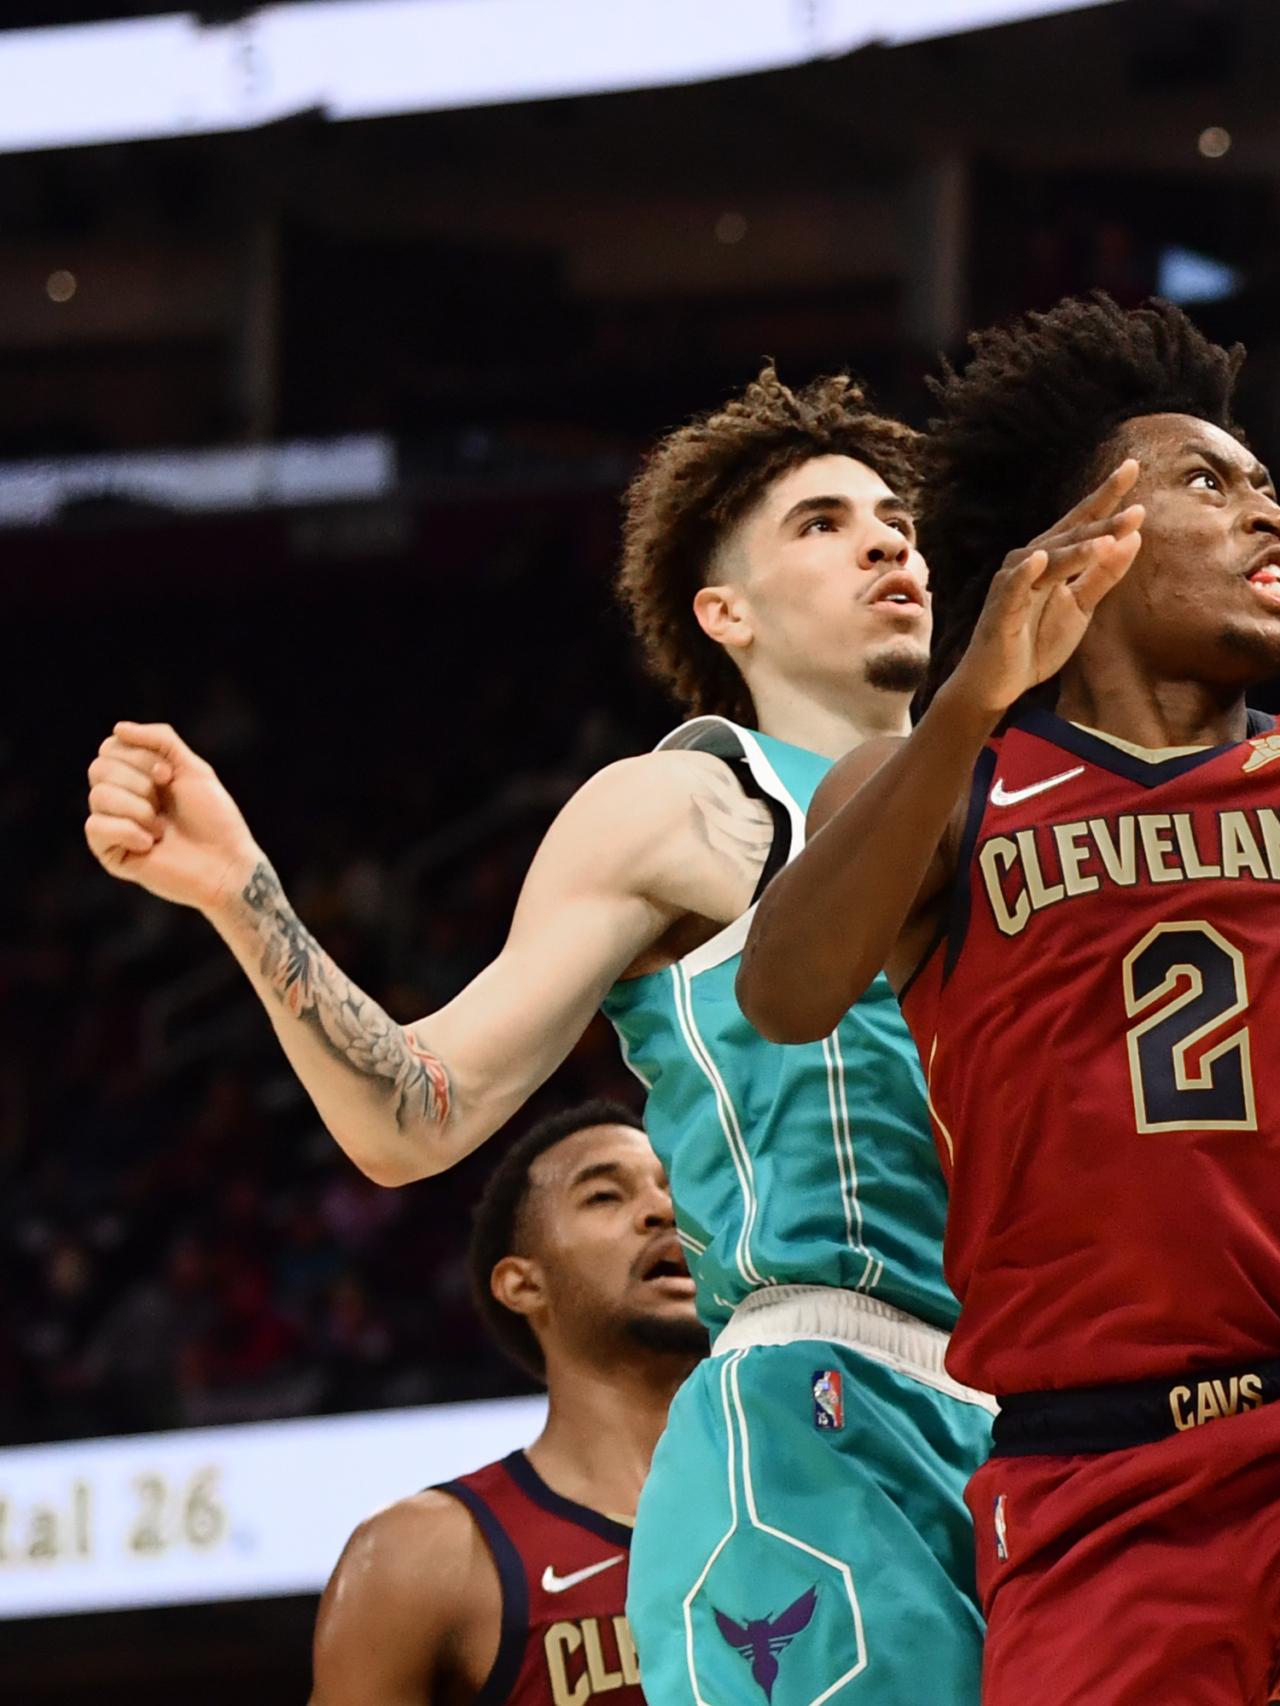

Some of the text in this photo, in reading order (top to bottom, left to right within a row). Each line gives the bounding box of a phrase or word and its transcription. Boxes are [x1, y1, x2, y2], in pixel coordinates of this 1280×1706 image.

[1122, 920, 1258, 1134] 2
[1168, 1373, 1263, 1432] CAVS
[130, 1463, 226, 1555] 26
